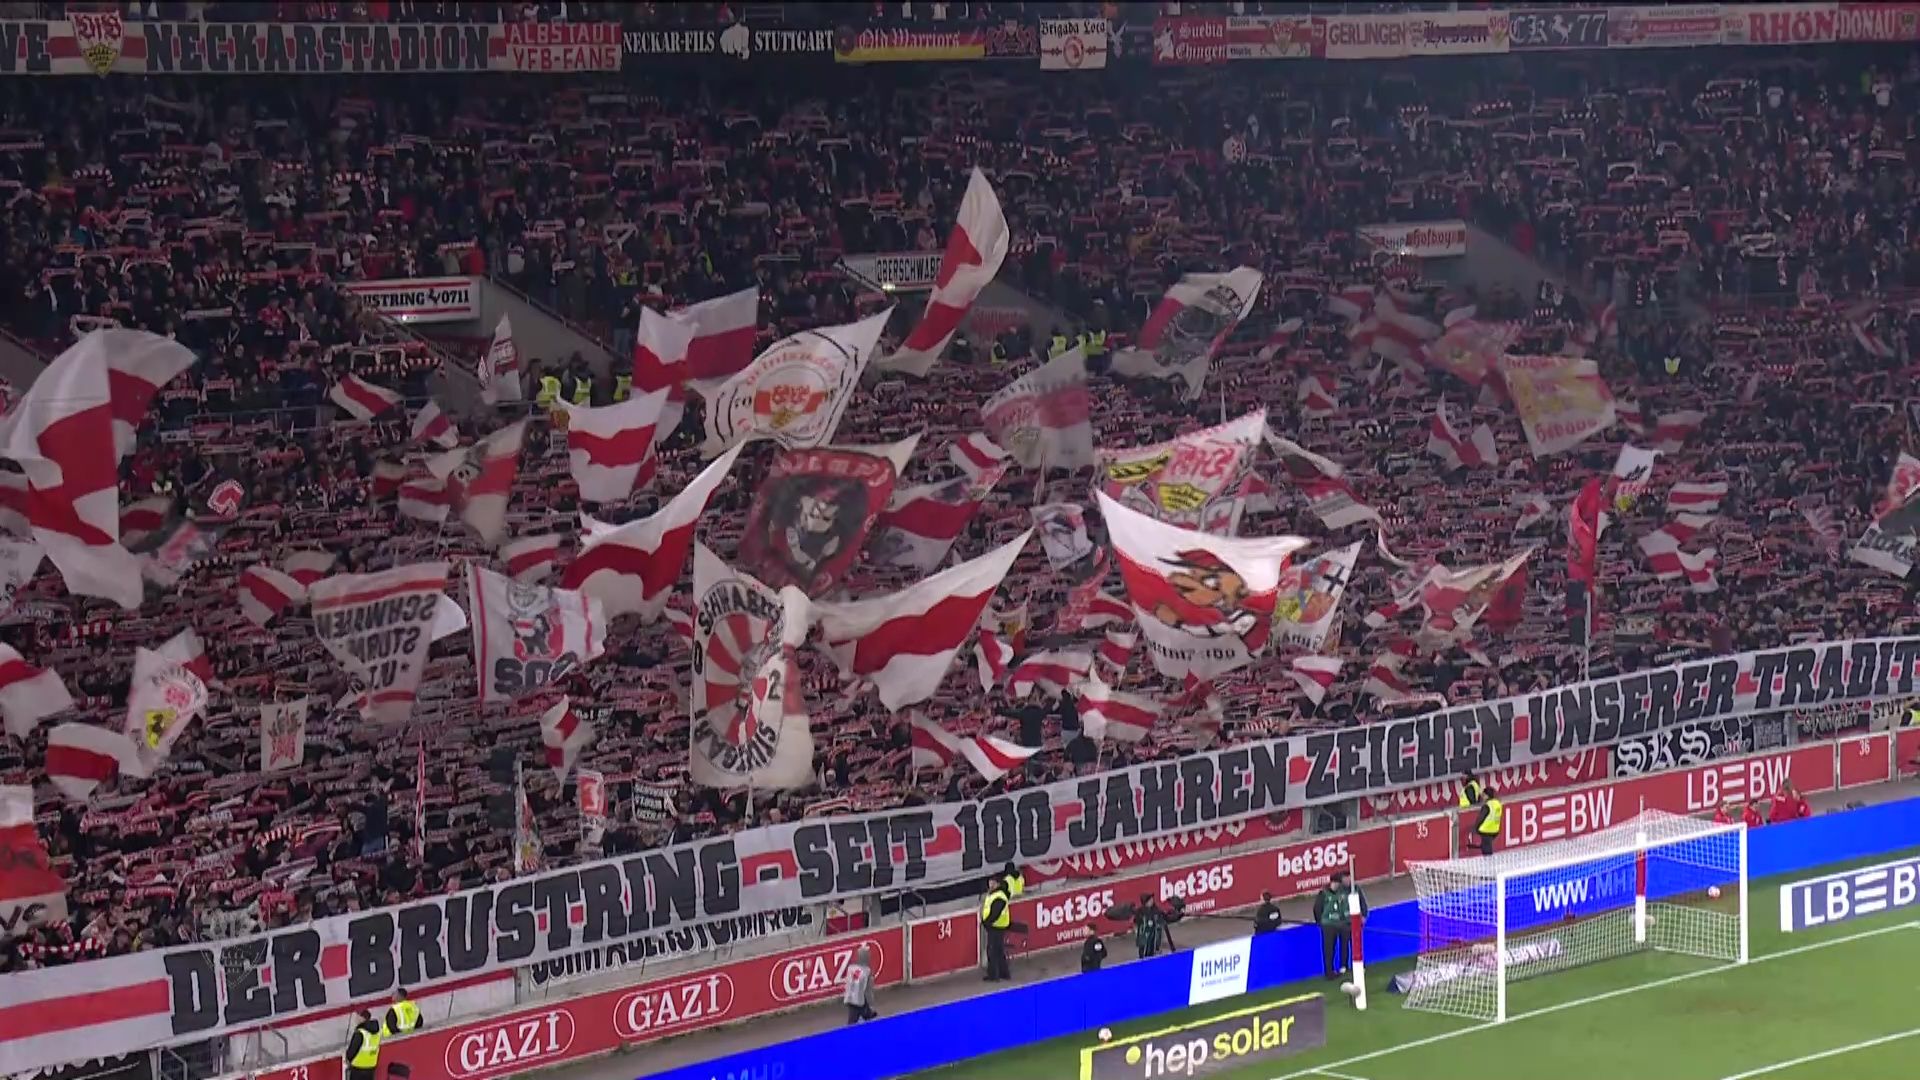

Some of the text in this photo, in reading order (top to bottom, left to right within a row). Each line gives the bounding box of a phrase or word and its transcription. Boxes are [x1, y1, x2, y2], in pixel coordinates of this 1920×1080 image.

[510, 23, 620, 44] ALBSTADT
[1041, 20, 1079, 38] Brigada
[1180, 21, 1223, 38] Suebia
[1329, 22, 1406, 46] GERLINGEN
[1578, 14, 1606, 42] 77
[1749, 10, 1836, 43] RHÖN
[1840, 10, 1895, 39] DONAU
[145, 24, 488, 72] NECKARSTADION
[623, 31, 834, 54] NECKAR-FILS STUTTGART
[860, 28, 960, 48] Old Warriors
[513, 47, 616, 70] VFB-FANS
[442, 289, 469, 303] 0711
[1859, 742, 1870, 757] 36
[164, 930, 326, 1036] DER
[348, 841, 740, 999] BRUSTRING
[793, 811, 934, 898] SEIT
[956, 791, 1051, 871] 100
[1069, 741, 1289, 848] JAHREN
[1306, 702, 1514, 799] ZEICHEN
[1529, 660, 1738, 755] UNSERER
[1753, 641, 1919, 709] TRADIT
[1416, 820, 1428, 839] 35
[1278, 842, 1348, 878] bet365
[1160, 865, 1233, 901] bet365
[1036, 890, 1114, 928] bet365
[938, 920, 952, 939] 34
[1214, 954, 1241, 976] MHP
[1145, 1015, 1295, 1078] hep solar
